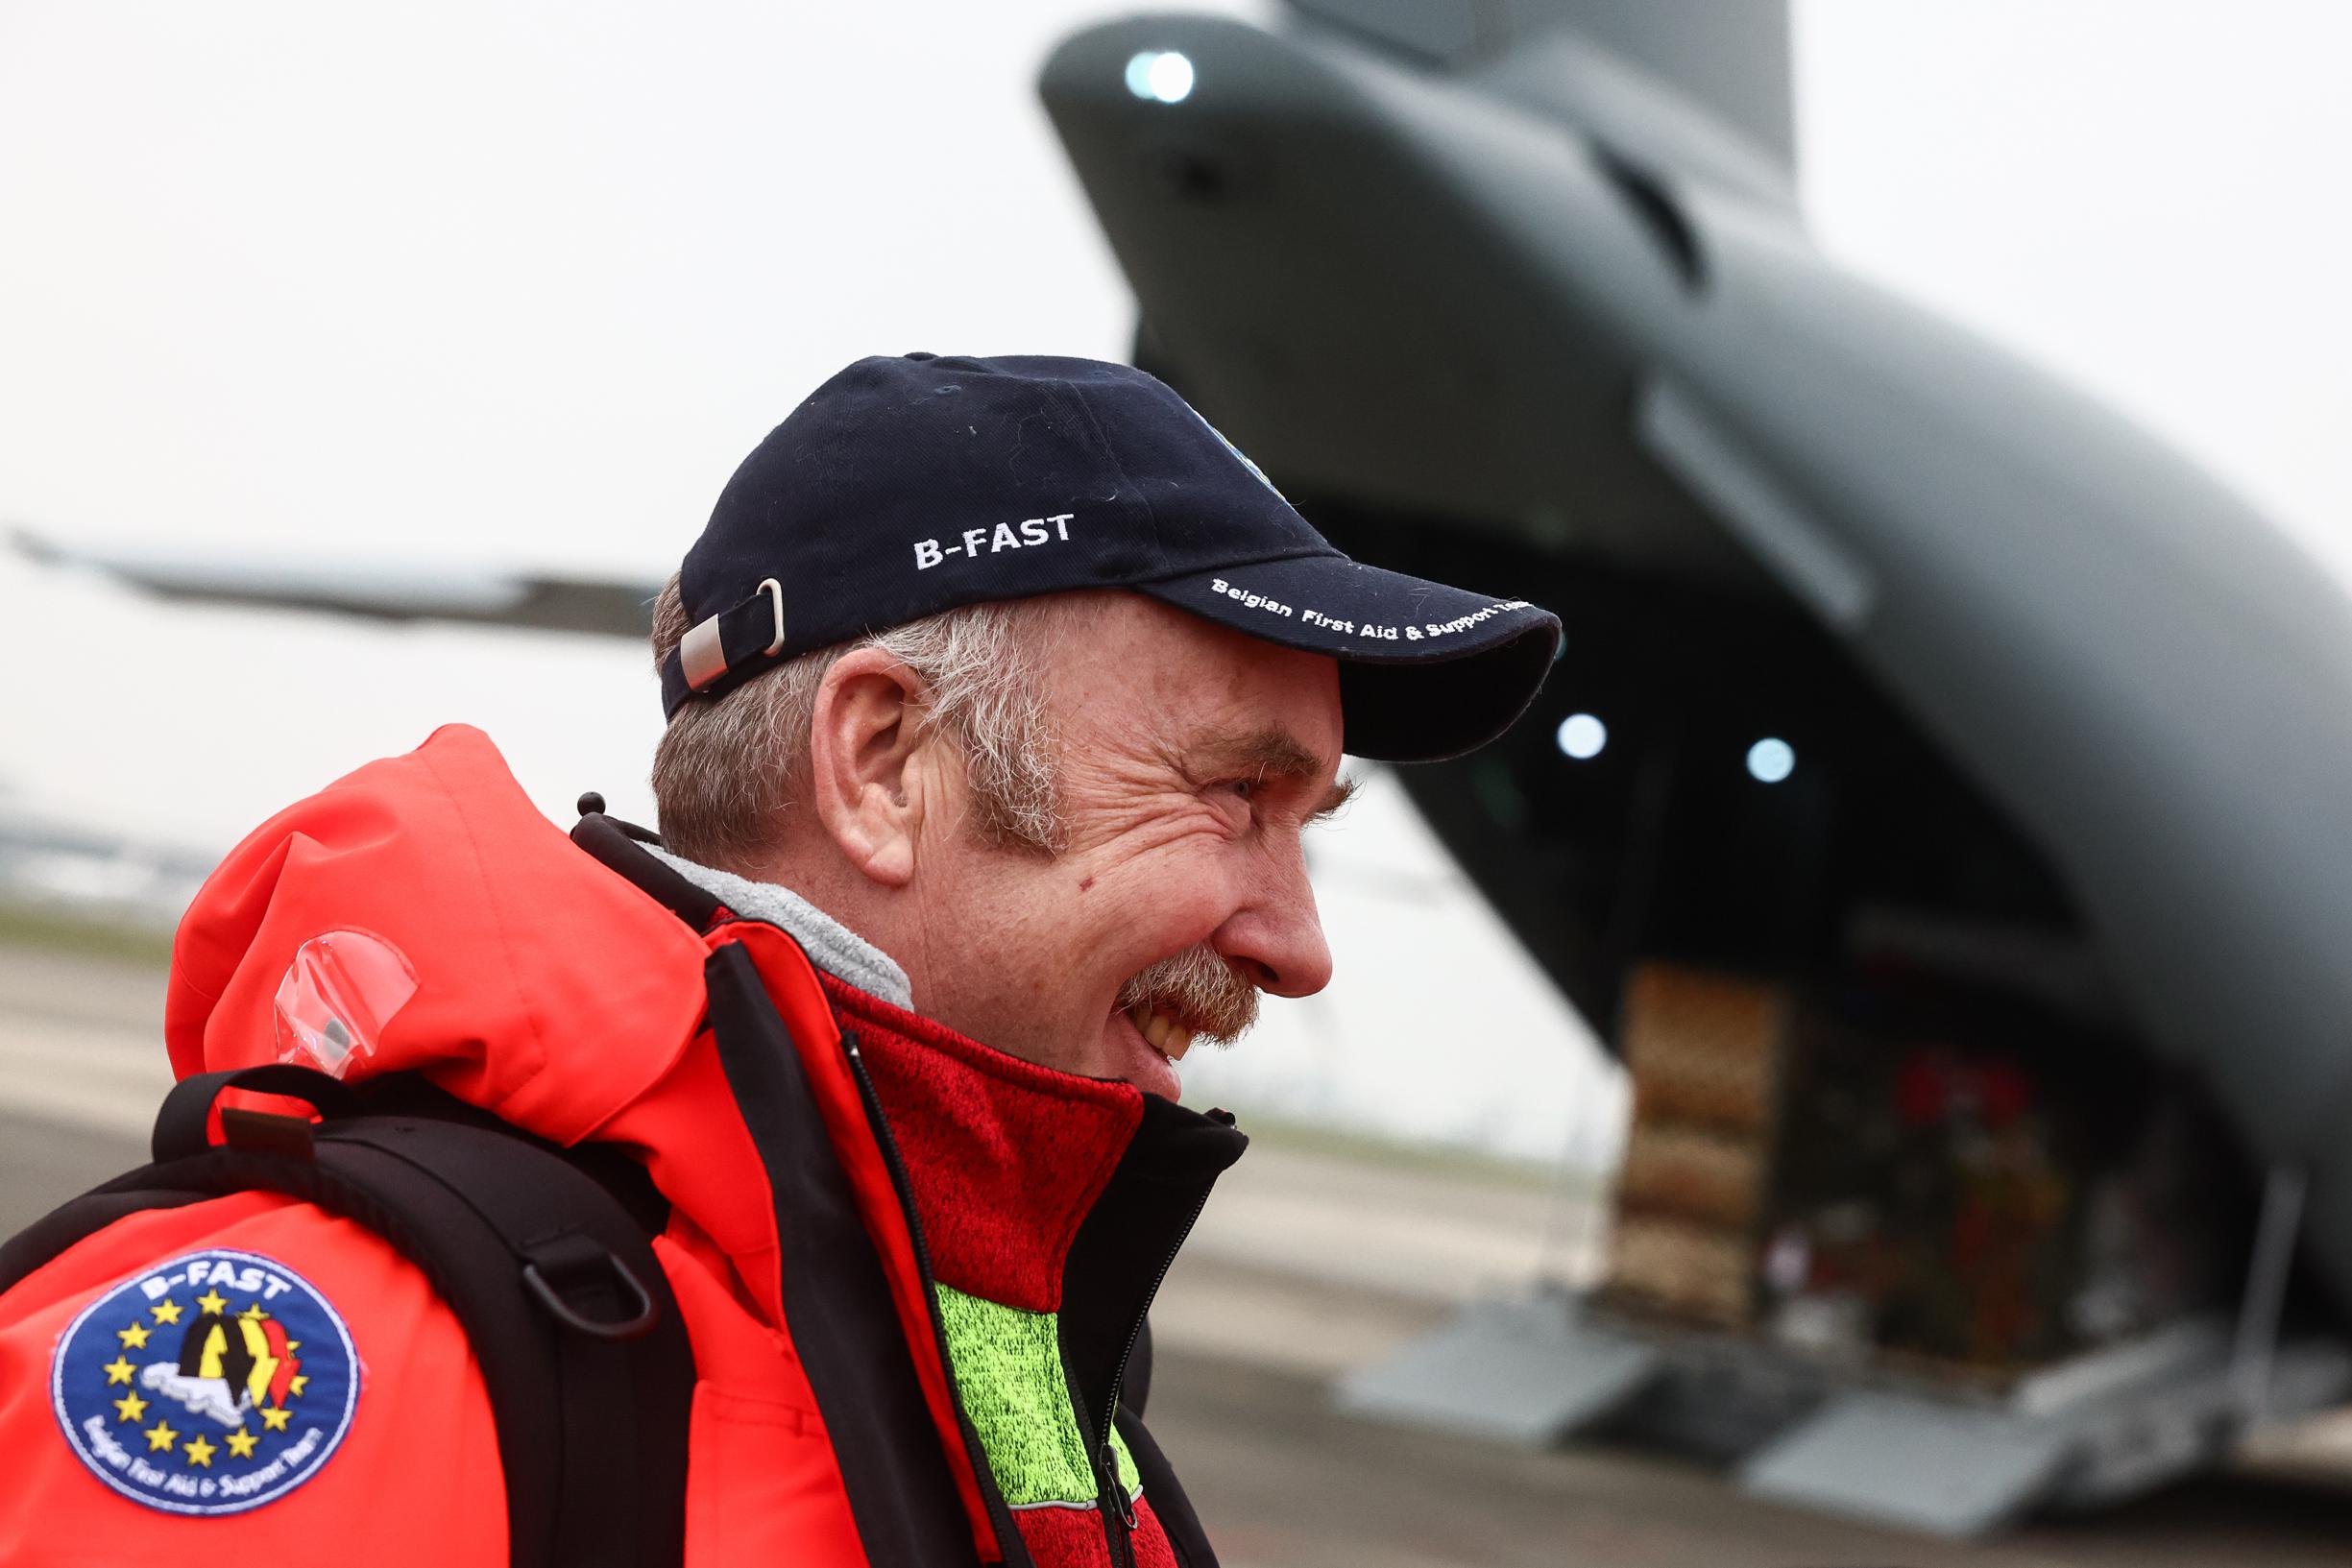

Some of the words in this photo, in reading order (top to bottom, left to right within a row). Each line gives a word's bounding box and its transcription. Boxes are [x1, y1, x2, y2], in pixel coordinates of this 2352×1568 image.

[914, 514, 1075, 570] B-FAST
[1211, 578, 1293, 617] Belgian
[1301, 610, 1354, 634] First
[1360, 624, 1398, 640] Aid
[1405, 626, 1424, 640] &
[1425, 608, 1498, 638] Support
[140, 1260, 292, 1300] B-FAST
[83, 1414, 133, 1472] Belgian
[127, 1457, 167, 1487] First
[163, 1473, 198, 1497] Aid
[218, 1459, 287, 1497] Support
